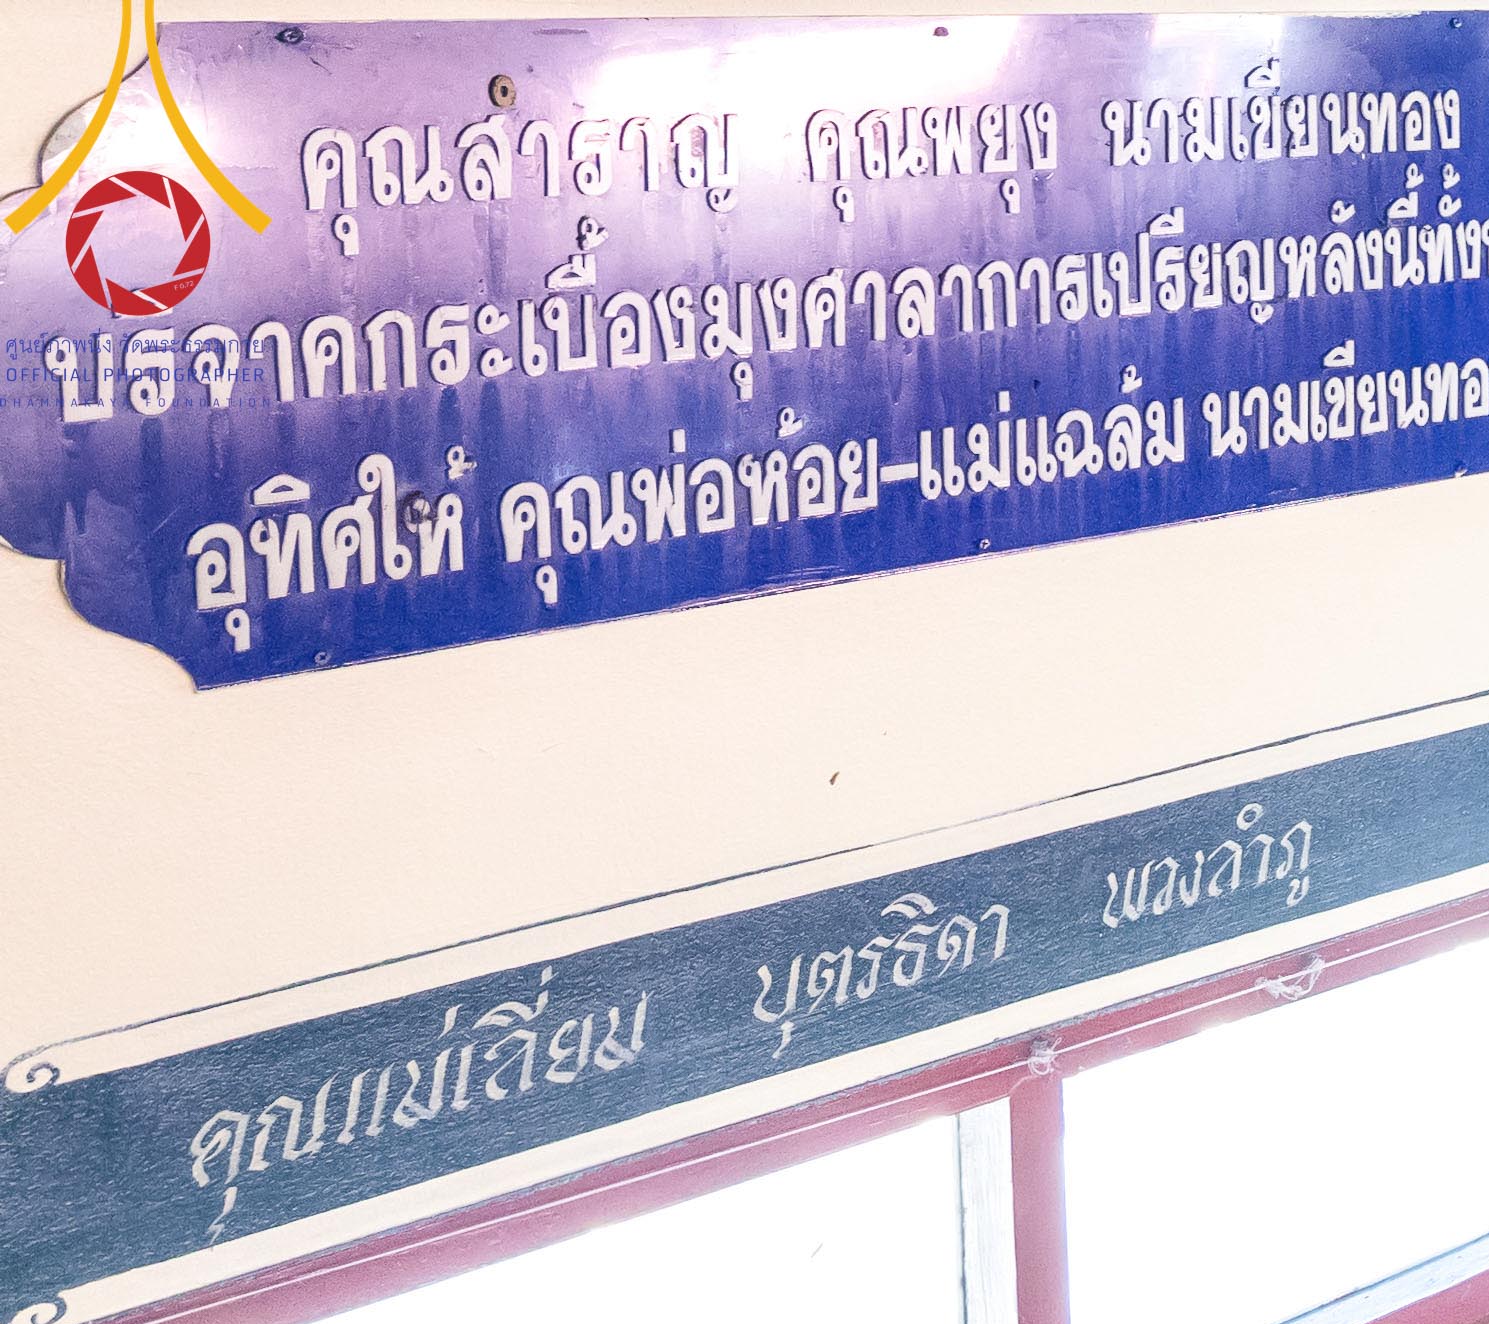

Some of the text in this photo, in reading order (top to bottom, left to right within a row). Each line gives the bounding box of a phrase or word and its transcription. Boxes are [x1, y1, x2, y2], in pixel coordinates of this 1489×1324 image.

[301, 57, 1462, 256] คุณสำราญ คุณพยุง นามเขียนทอง
[186, 444, 477, 653] อุทิศให้
[753, 892, 1012, 1060] บุตรธิดา
[1103, 802, 1314, 928] พวงลำภู
